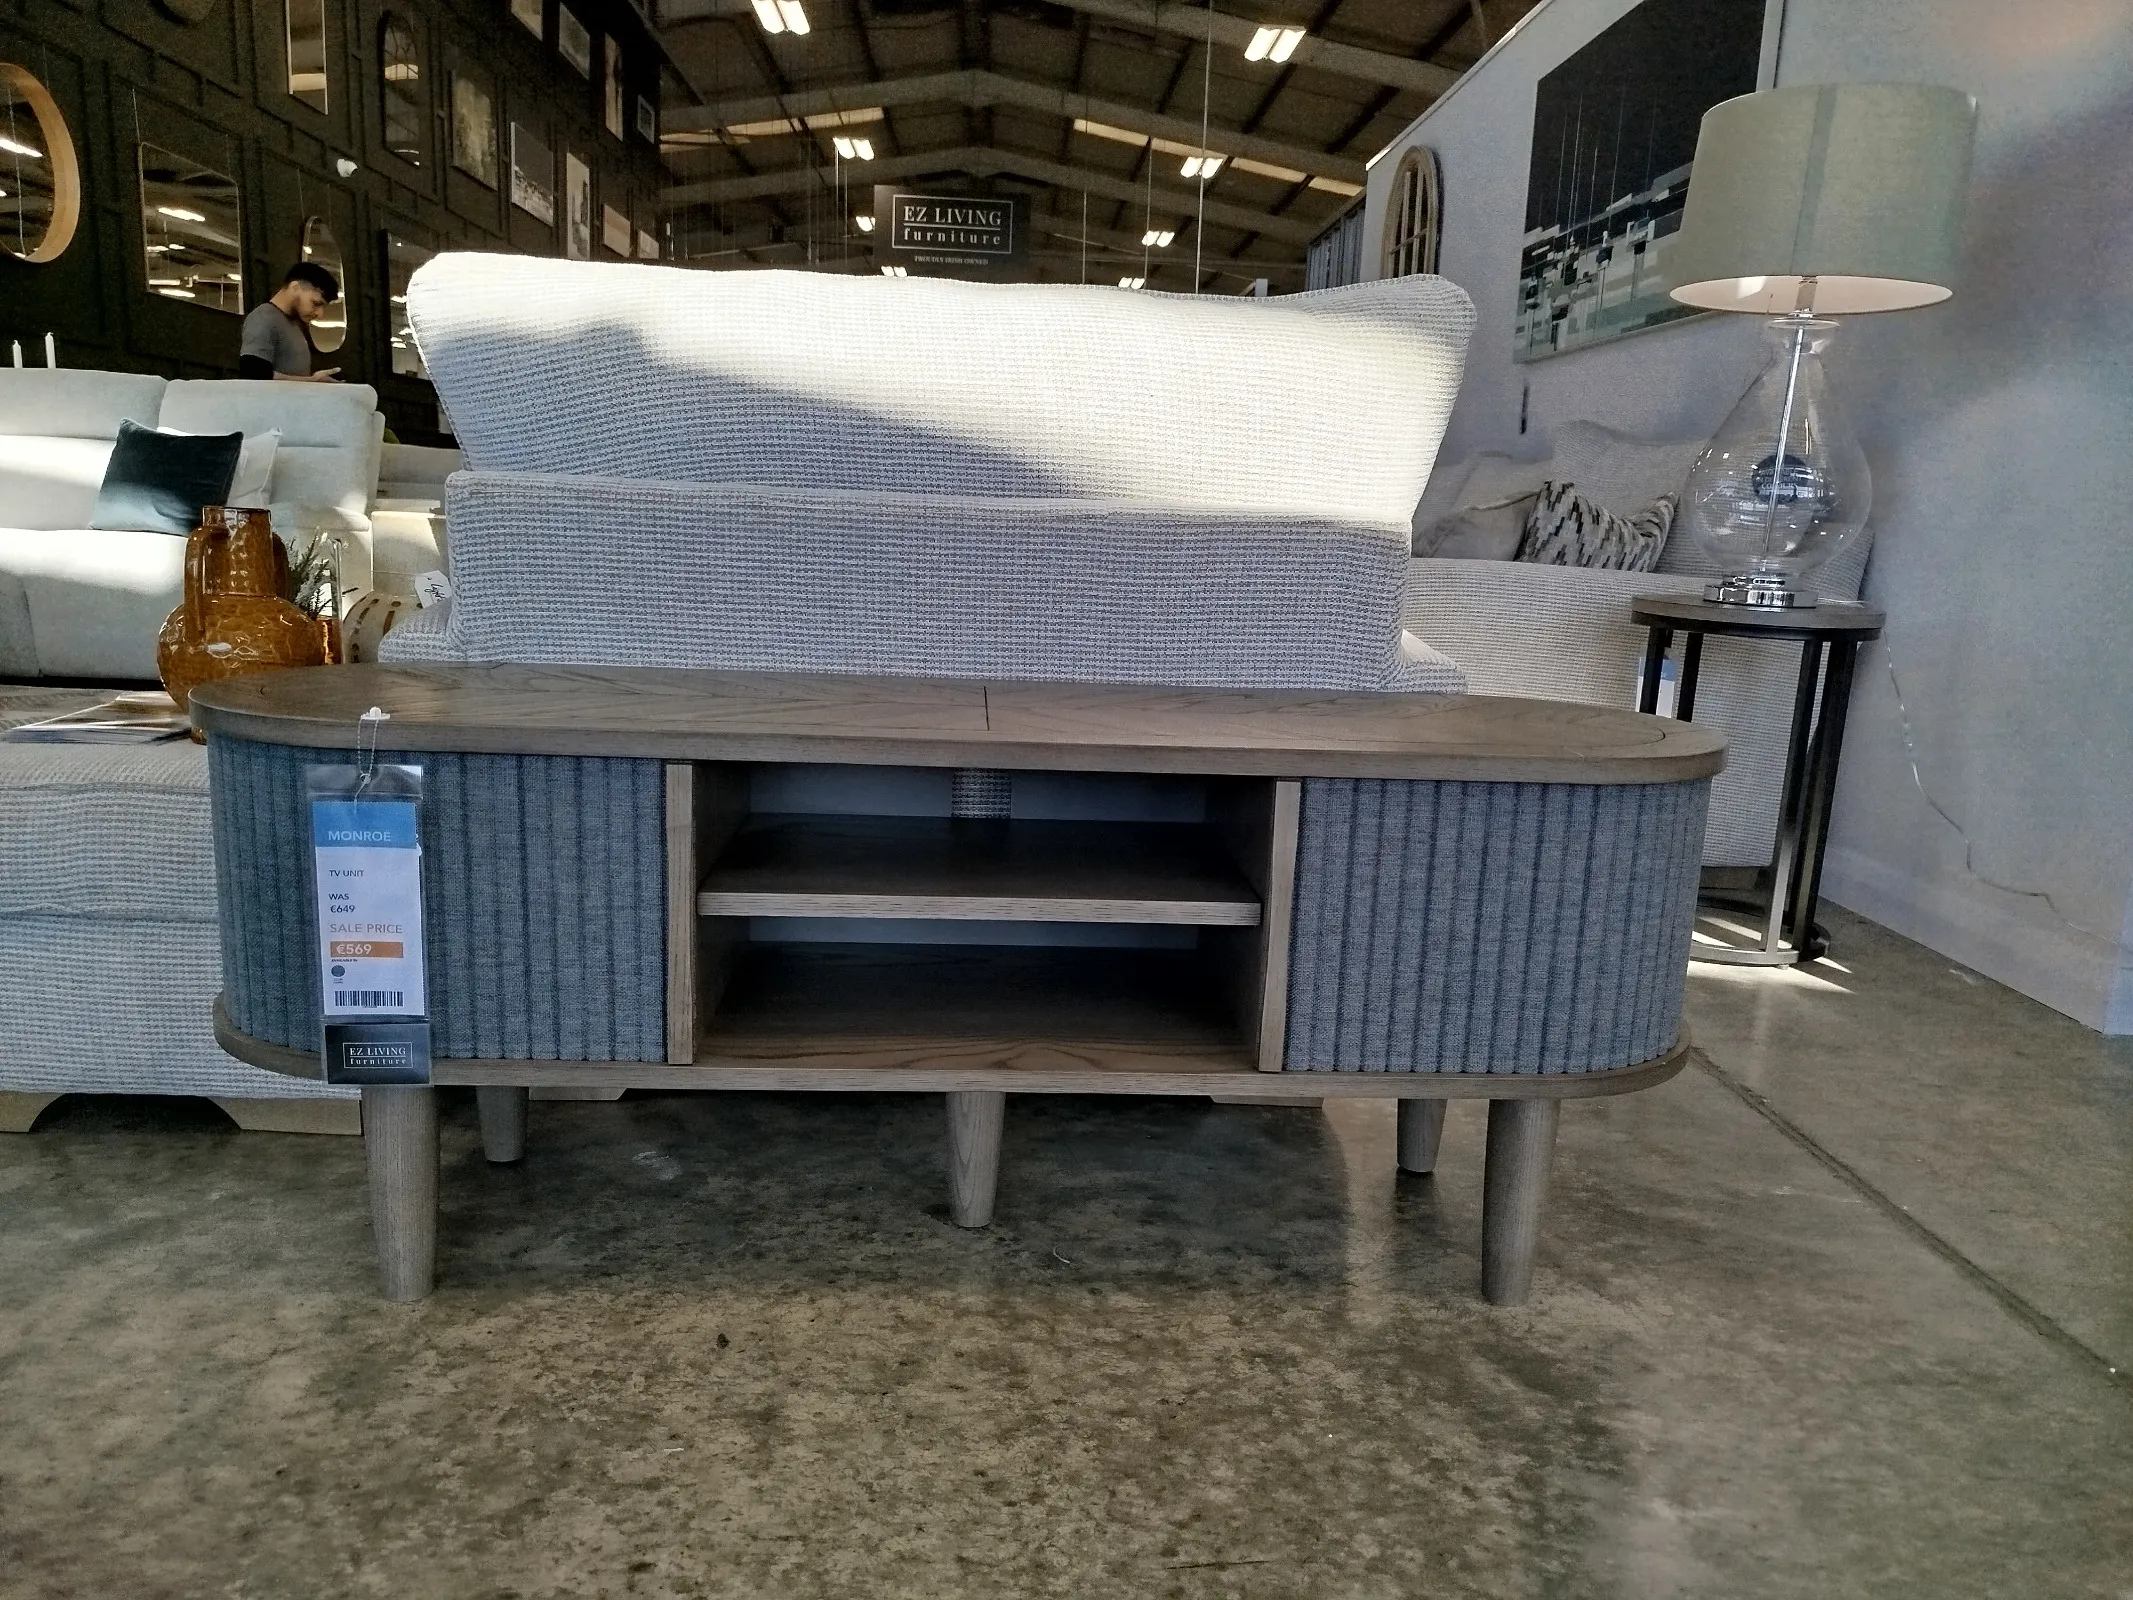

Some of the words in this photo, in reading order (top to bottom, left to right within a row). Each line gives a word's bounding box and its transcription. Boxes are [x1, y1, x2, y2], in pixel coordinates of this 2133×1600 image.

[904, 205, 927, 222] EZ
[935, 207, 1002, 226] LIVING
[904, 228, 1001, 245] furniture
[328, 830, 391, 842] MONROE
[329, 869, 341, 877] TV
[342, 869, 364, 877] UNIT
[328, 893, 350, 901] WAS
[330, 904, 356, 913] €649
[330, 923, 362, 933] SALE
[367, 923, 403, 934] PRICE
[336, 943, 372, 955] €569
[349, 1047, 364, 1056] EZ
[367, 1047, 406, 1056] LIVING
